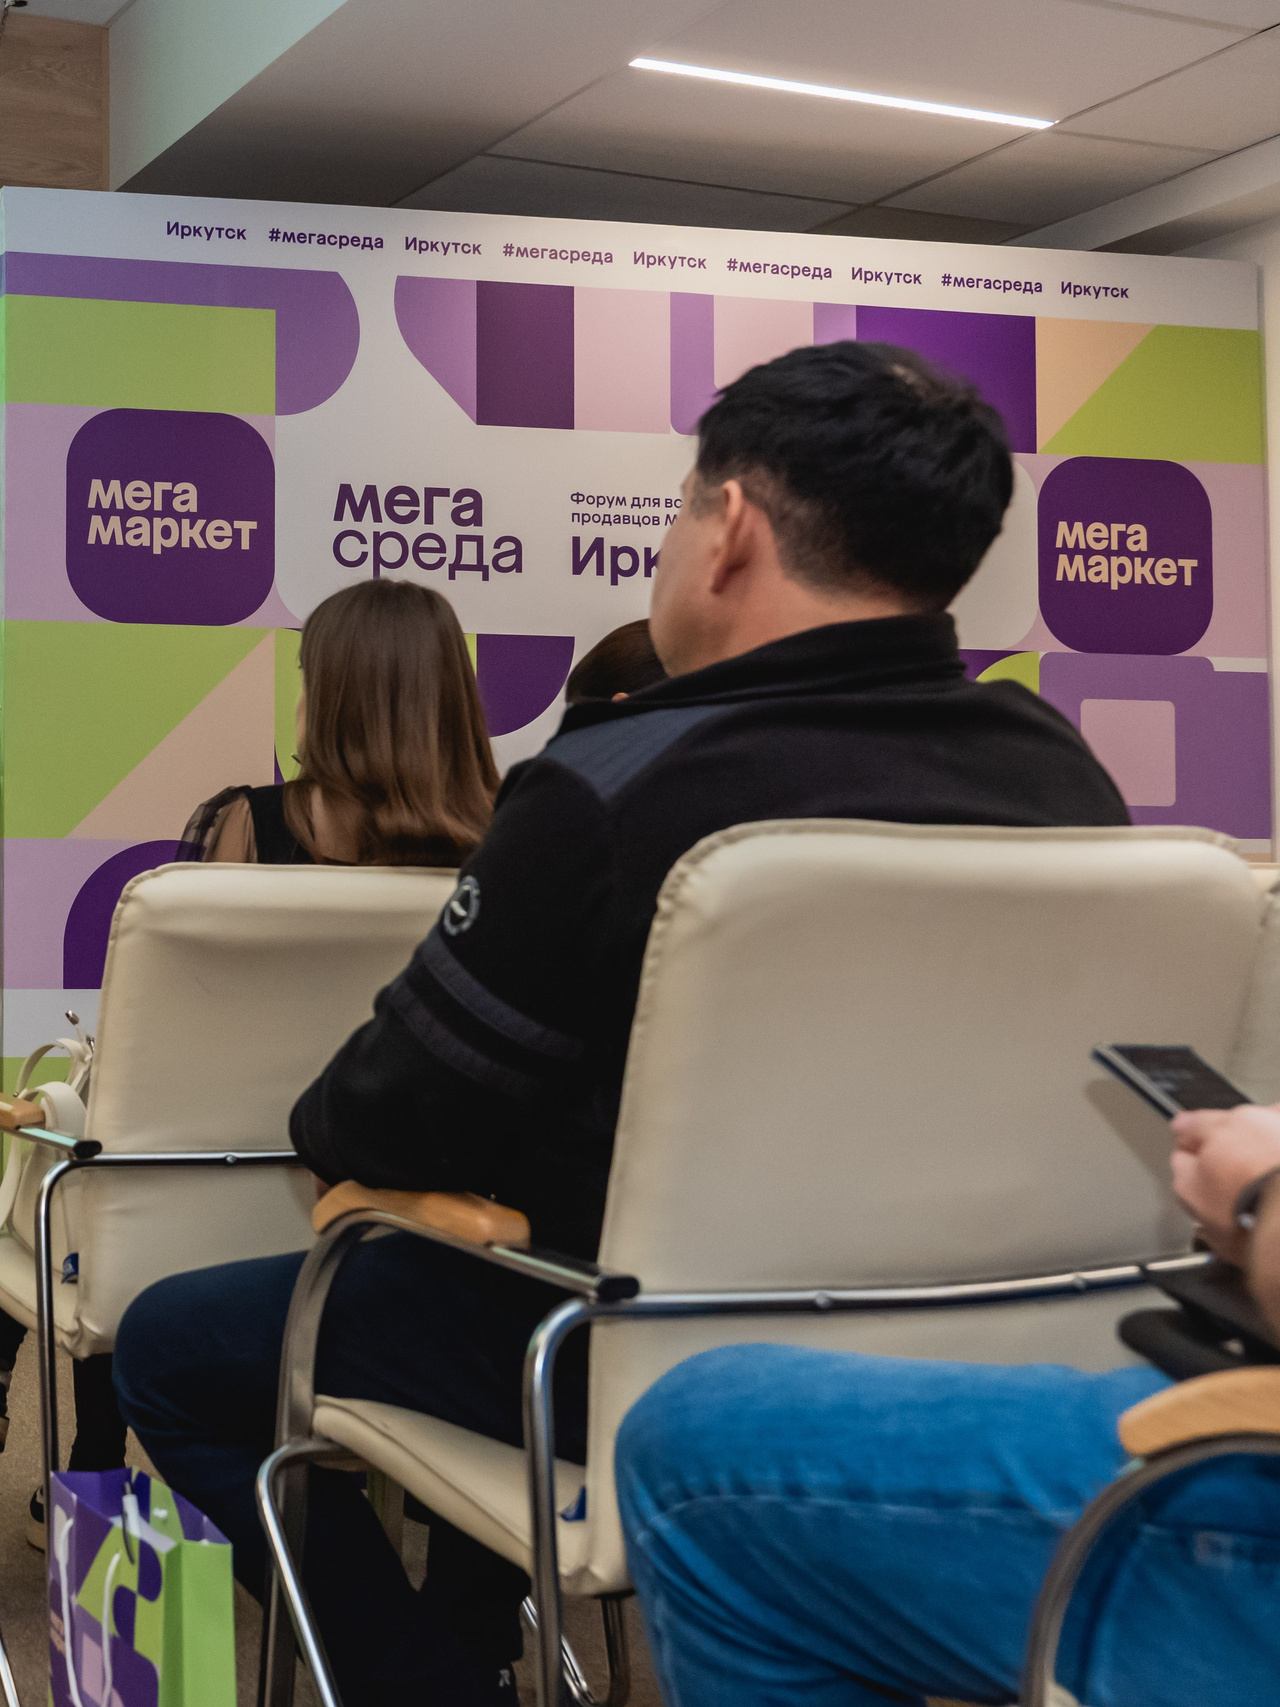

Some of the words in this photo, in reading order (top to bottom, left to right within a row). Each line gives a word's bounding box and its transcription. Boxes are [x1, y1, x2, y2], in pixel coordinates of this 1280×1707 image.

[166, 221, 247, 242] Иркутск
[268, 227, 385, 251] #мегасреда
[404, 236, 482, 257] Иркутск
[502, 242, 613, 266] #мегасреда
[633, 251, 707, 271] Иркутск
[726, 258, 833, 281] #мегасреда
[851, 266, 922, 286] Иркутск
[941, 273, 1043, 295] #мегасреда
[1061, 281, 1129, 300] Иркутск
[87, 478, 198, 512] мега
[333, 483, 483, 528] мега
[570, 491, 627, 508] Форум
[630, 496, 660, 509] для
[664, 497, 683, 509] вс
[87, 513, 258, 555] маркет
[571, 512, 660, 527] продавцов
[1055, 521, 1148, 552] мега
[332, 528, 523, 581] среда
[1055, 552, 1198, 590] маркет
